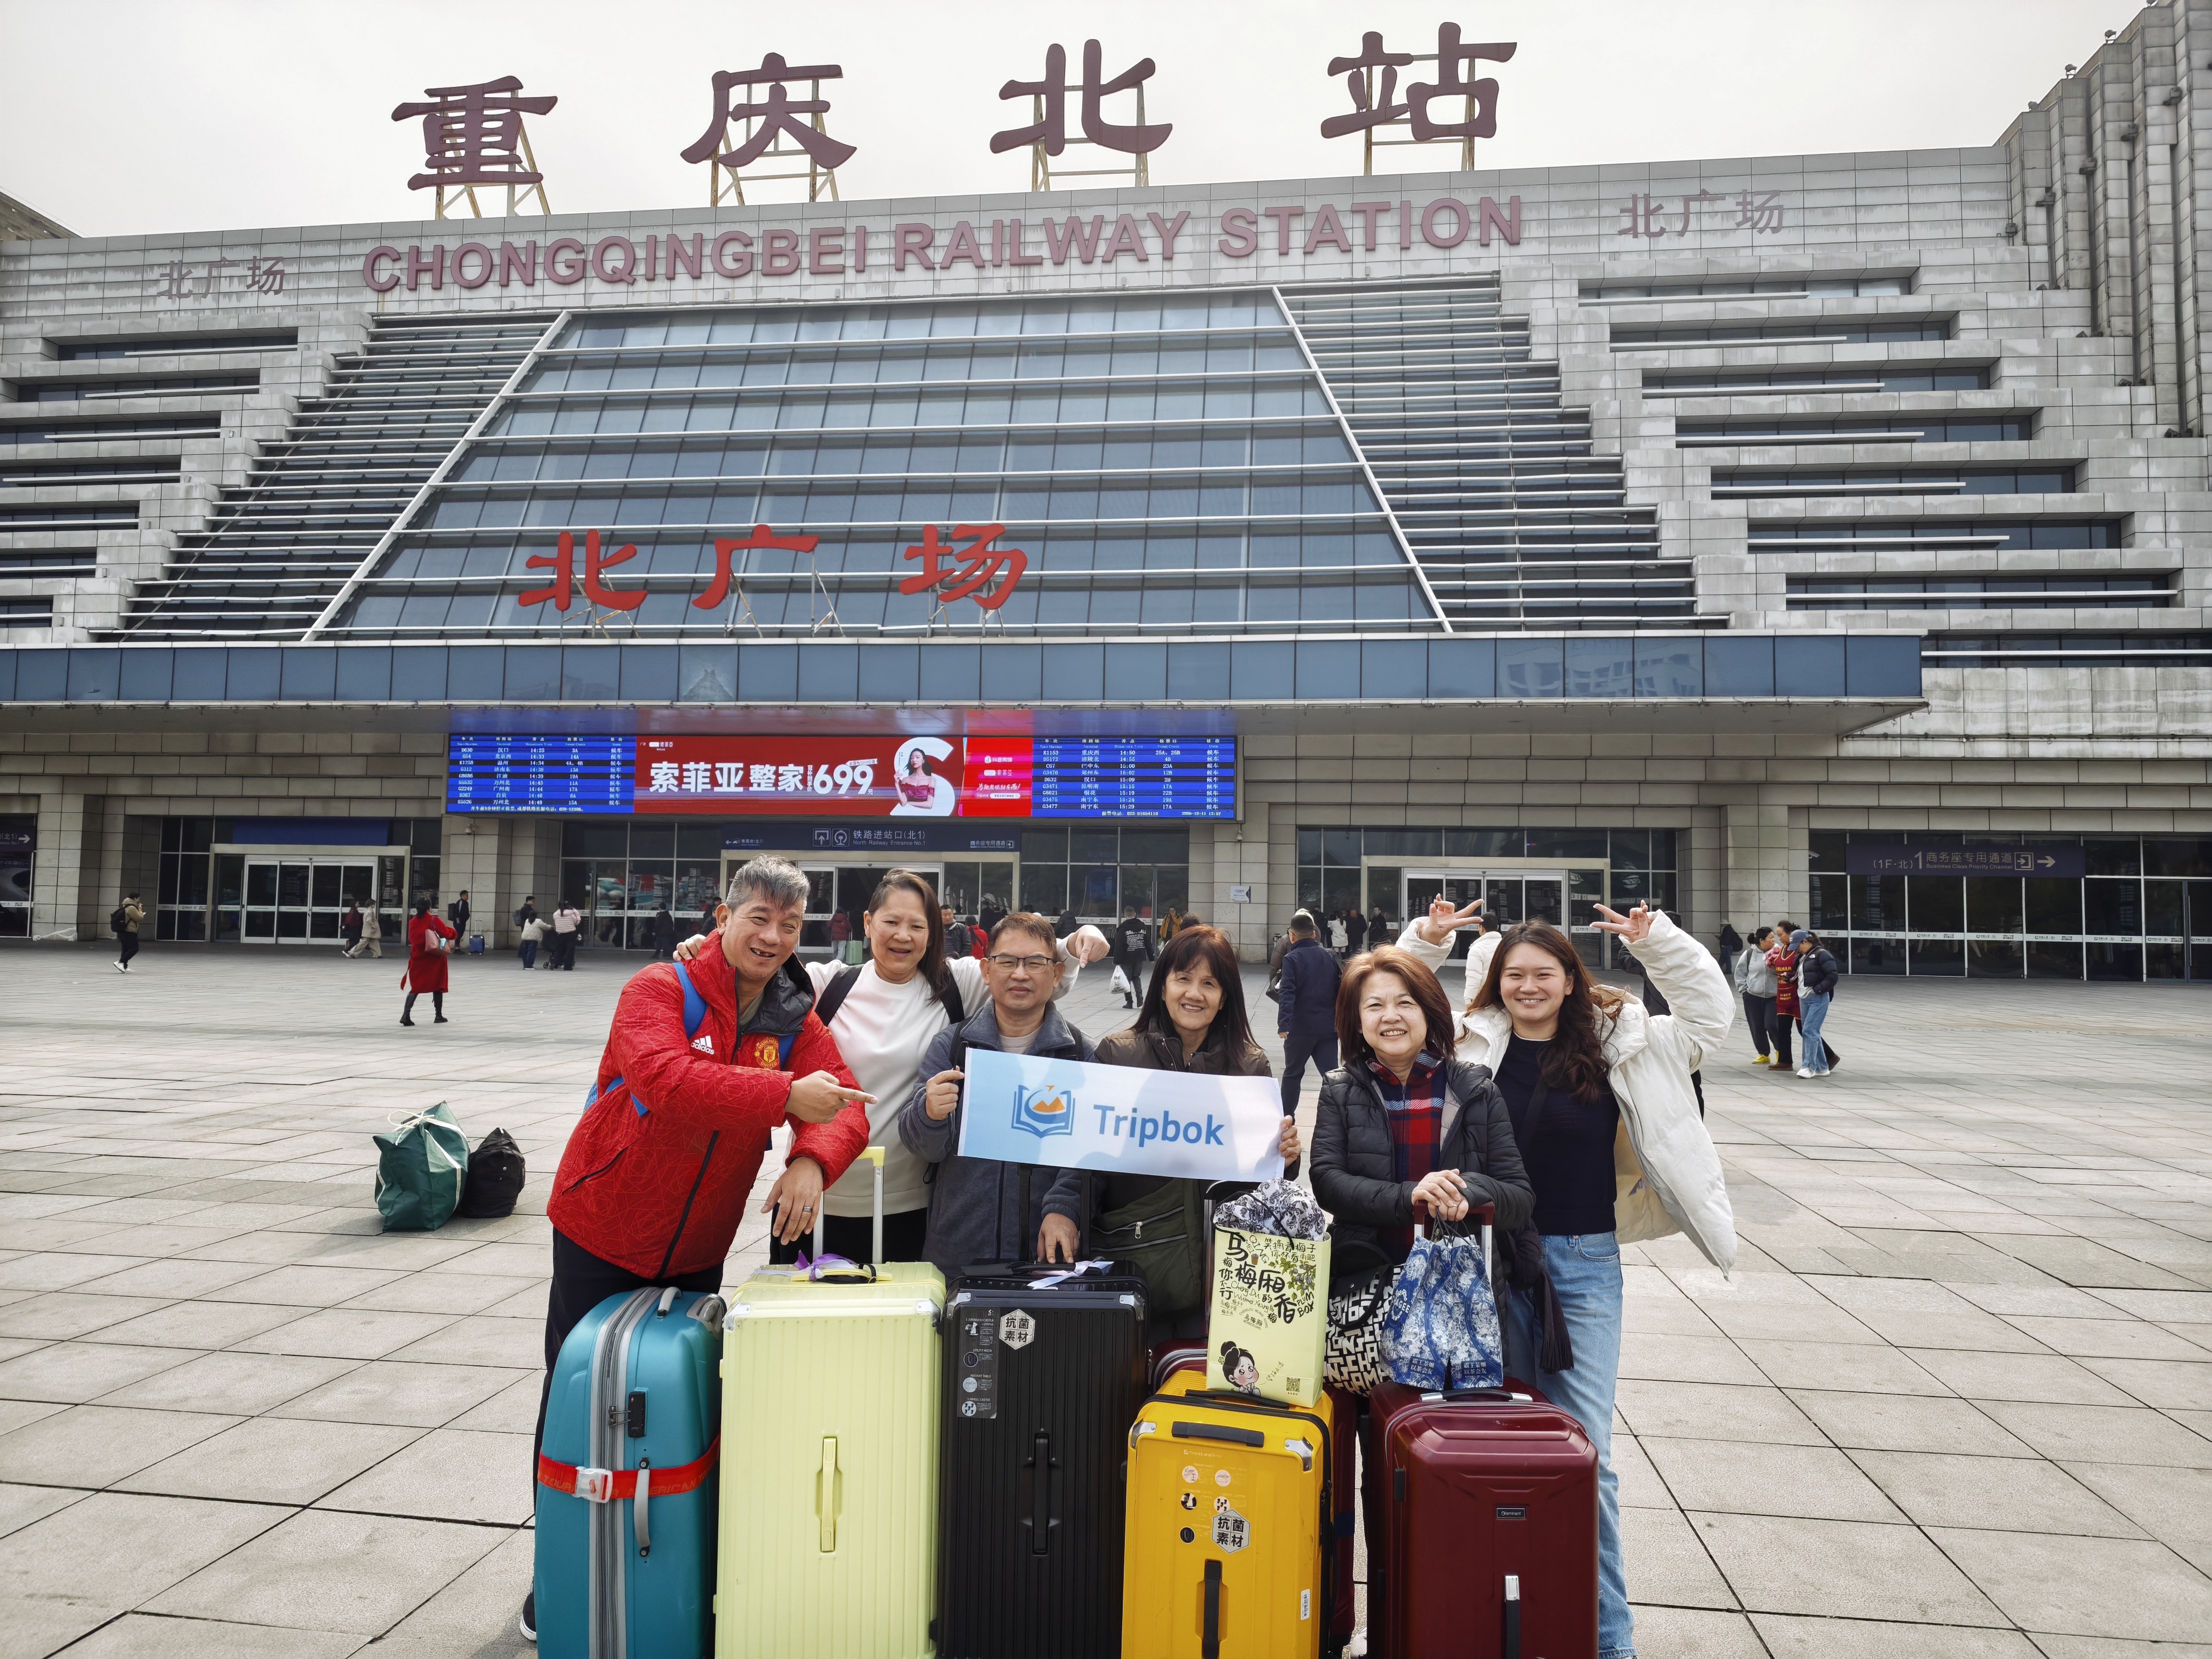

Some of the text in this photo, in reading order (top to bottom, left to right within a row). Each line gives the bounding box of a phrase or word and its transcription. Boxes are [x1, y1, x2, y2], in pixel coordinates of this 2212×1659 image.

[391, 22, 1516, 190] 重庆北站
[1617, 188, 1784, 238] 北广场
[362, 195, 1521, 292] CHONGQINGBEI RAILWAY STATION
[157, 256, 285, 299] 北广场
[518, 523, 1028, 610] 北广场
[649, 761, 744, 793] 索菲亚
[749, 764, 804, 792] 整家
[813, 765, 873, 794] 699
[853, 830, 925, 840] 铁路进站口(北1)
[1926, 852, 2013, 863] 商务座专用通道
[691, 1042, 714, 1055] adidas
[1094, 1104, 1225, 1148] Tripbok
[1231, 1281, 1259, 1299] Cheng Du
[1262, 1294, 1272, 1303] 的
[1297, 1291, 1314, 1306] PLUM
[1233, 1292, 1269, 1313] Wumei Xiang
[1297, 1300, 1314, 1317] BOX
[1006, 1317, 1029, 1330] 抗菌
[1004, 1330, 1028, 1343] 素材
[1411, 1365, 1433, 1374] 以茶会友
[1412, 1358, 1435, 1368] 霸王茶姬
[1218, 1516, 1244, 1533] 抗菌
[1217, 1532, 1243, 1548] 素材
